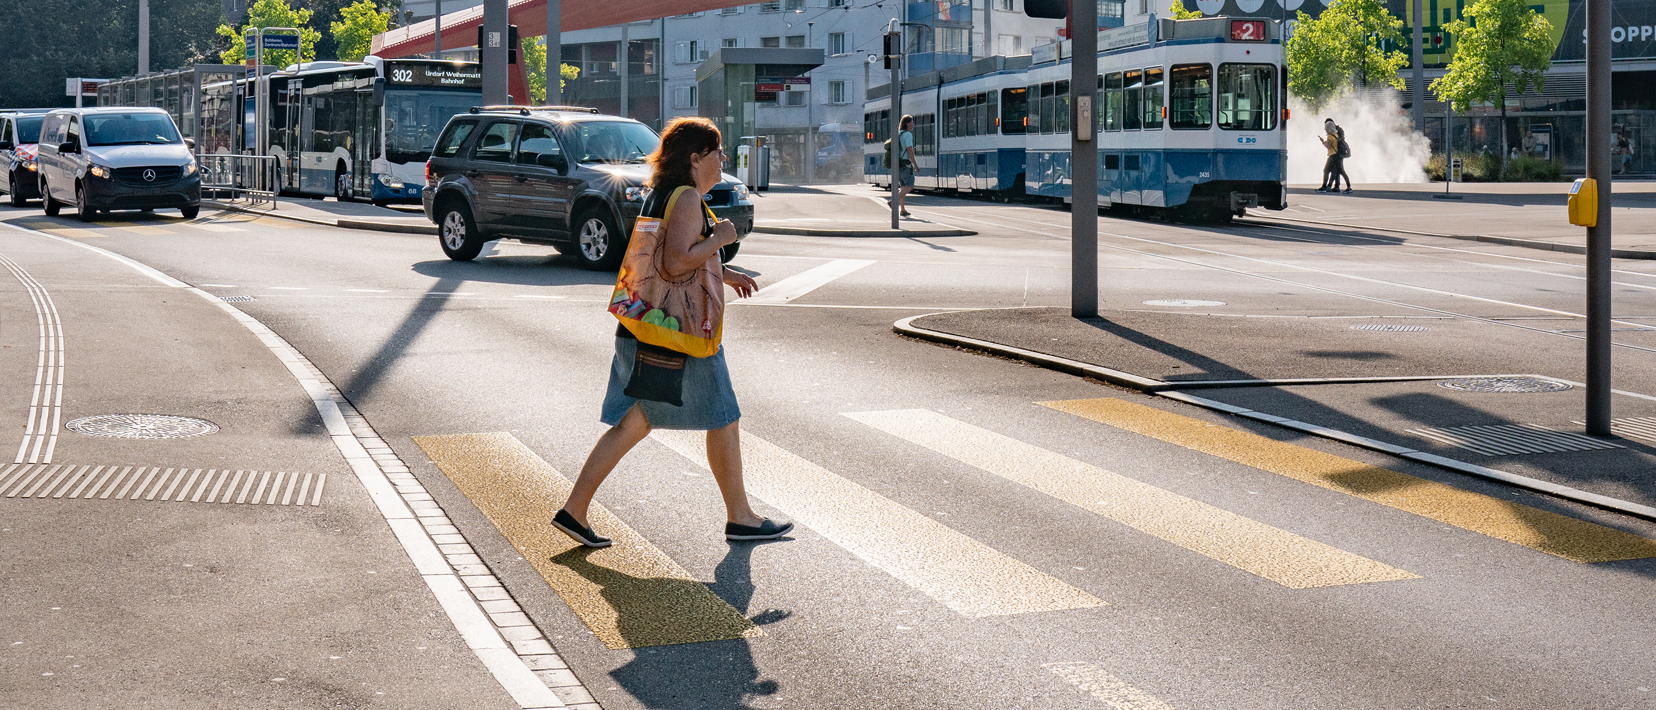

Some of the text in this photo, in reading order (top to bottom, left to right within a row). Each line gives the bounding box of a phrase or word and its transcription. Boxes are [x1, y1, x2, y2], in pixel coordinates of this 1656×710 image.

[1242, 22, 1254, 40] 2
[392, 69, 413, 82] 302
[446, 71, 481, 79] Weihermatt
